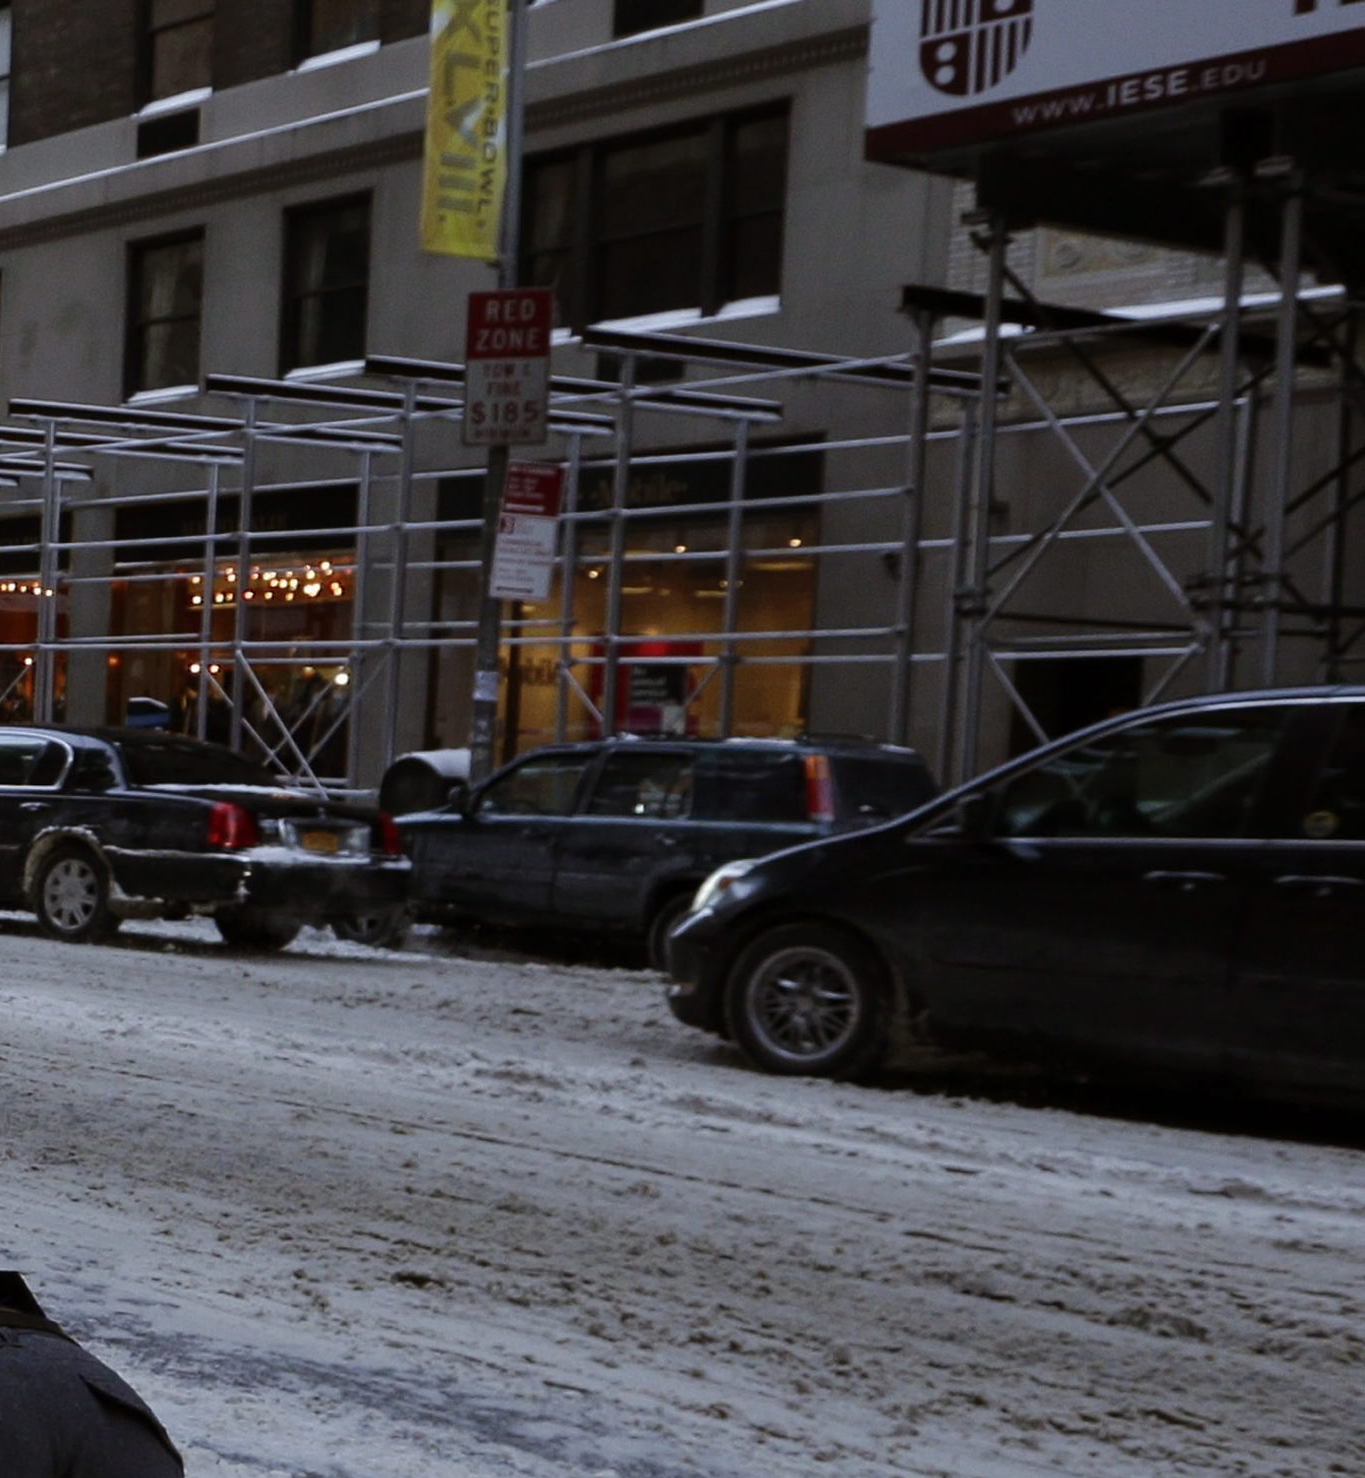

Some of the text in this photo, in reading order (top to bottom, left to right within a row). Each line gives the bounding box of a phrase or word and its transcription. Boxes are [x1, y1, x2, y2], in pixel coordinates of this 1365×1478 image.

[484, 298, 537, 322] RED
[474, 326, 541, 351] ZONE
[471, 401, 539, 425] $185
